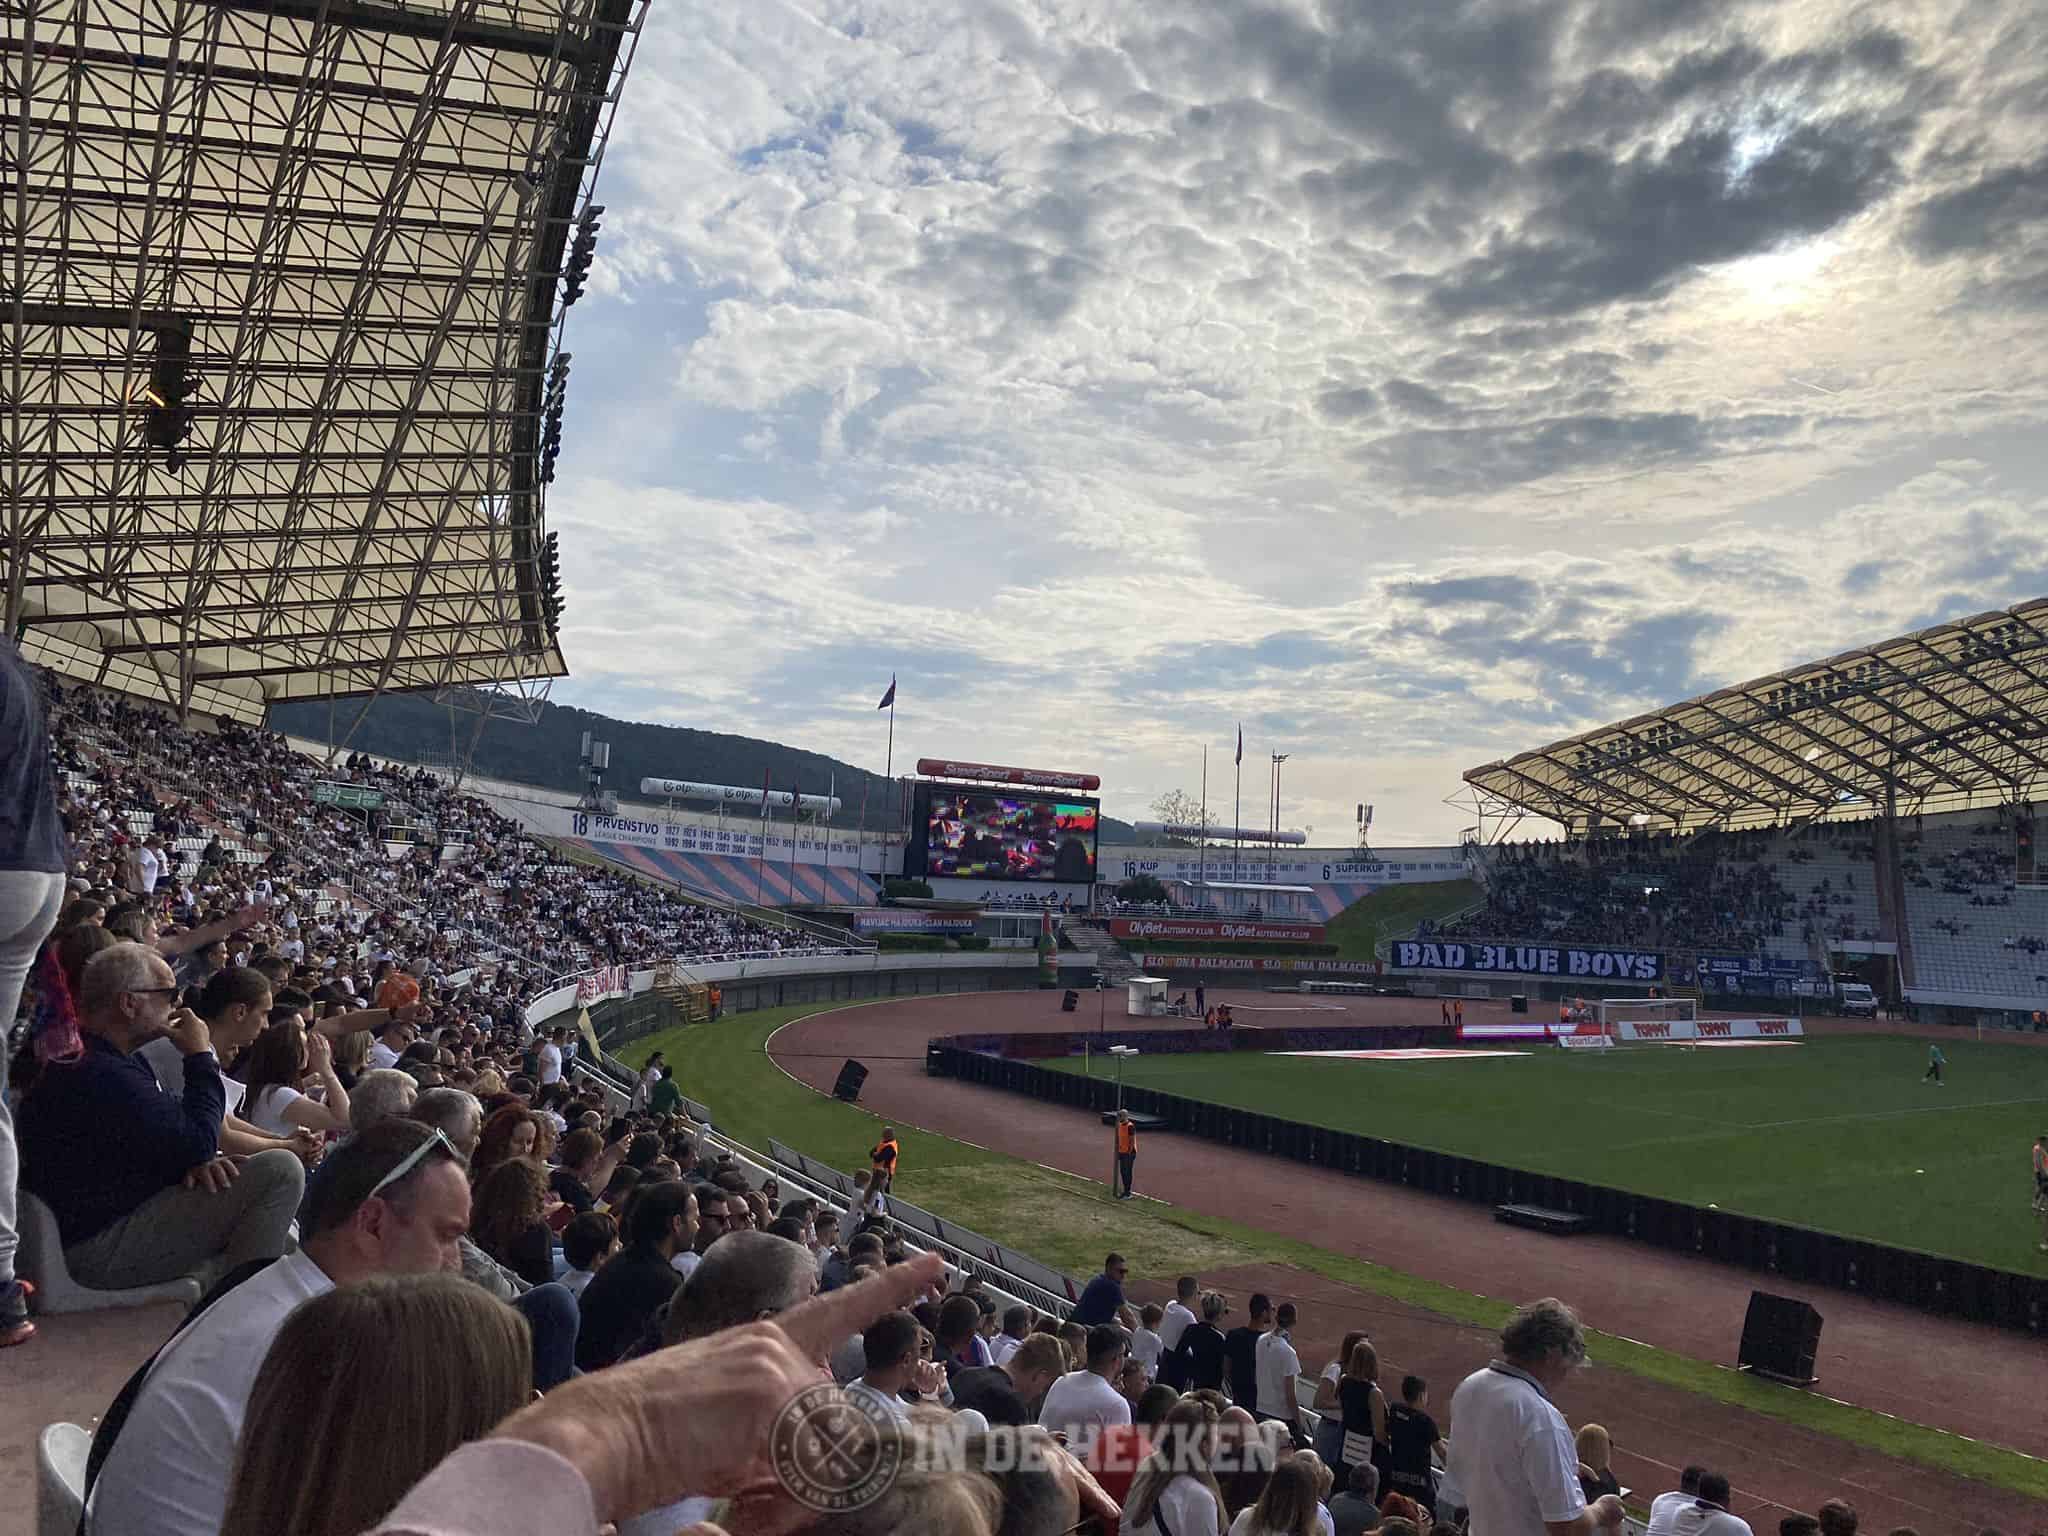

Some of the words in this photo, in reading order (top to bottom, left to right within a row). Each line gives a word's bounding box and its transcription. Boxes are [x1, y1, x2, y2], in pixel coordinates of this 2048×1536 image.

[943, 764, 1010, 780] SuperSport
[1022, 771, 1085, 786] SuperSport
[572, 813, 588, 836] 18
[595, 816, 659, 835] PRVENSTVO
[1123, 861, 1136, 878] 16
[1140, 862, 1159, 871] KUP
[1322, 865, 1331, 881] 6
[1335, 863, 1385, 873] SUPERKUP
[1129, 921, 1163, 937] OlyBet
[1221, 924, 1256, 939] OlyBet
[1400, 943, 1464, 968] BAD
[1475, 946, 1559, 973] BLUE
[1568, 950, 1657, 978] BOYS
